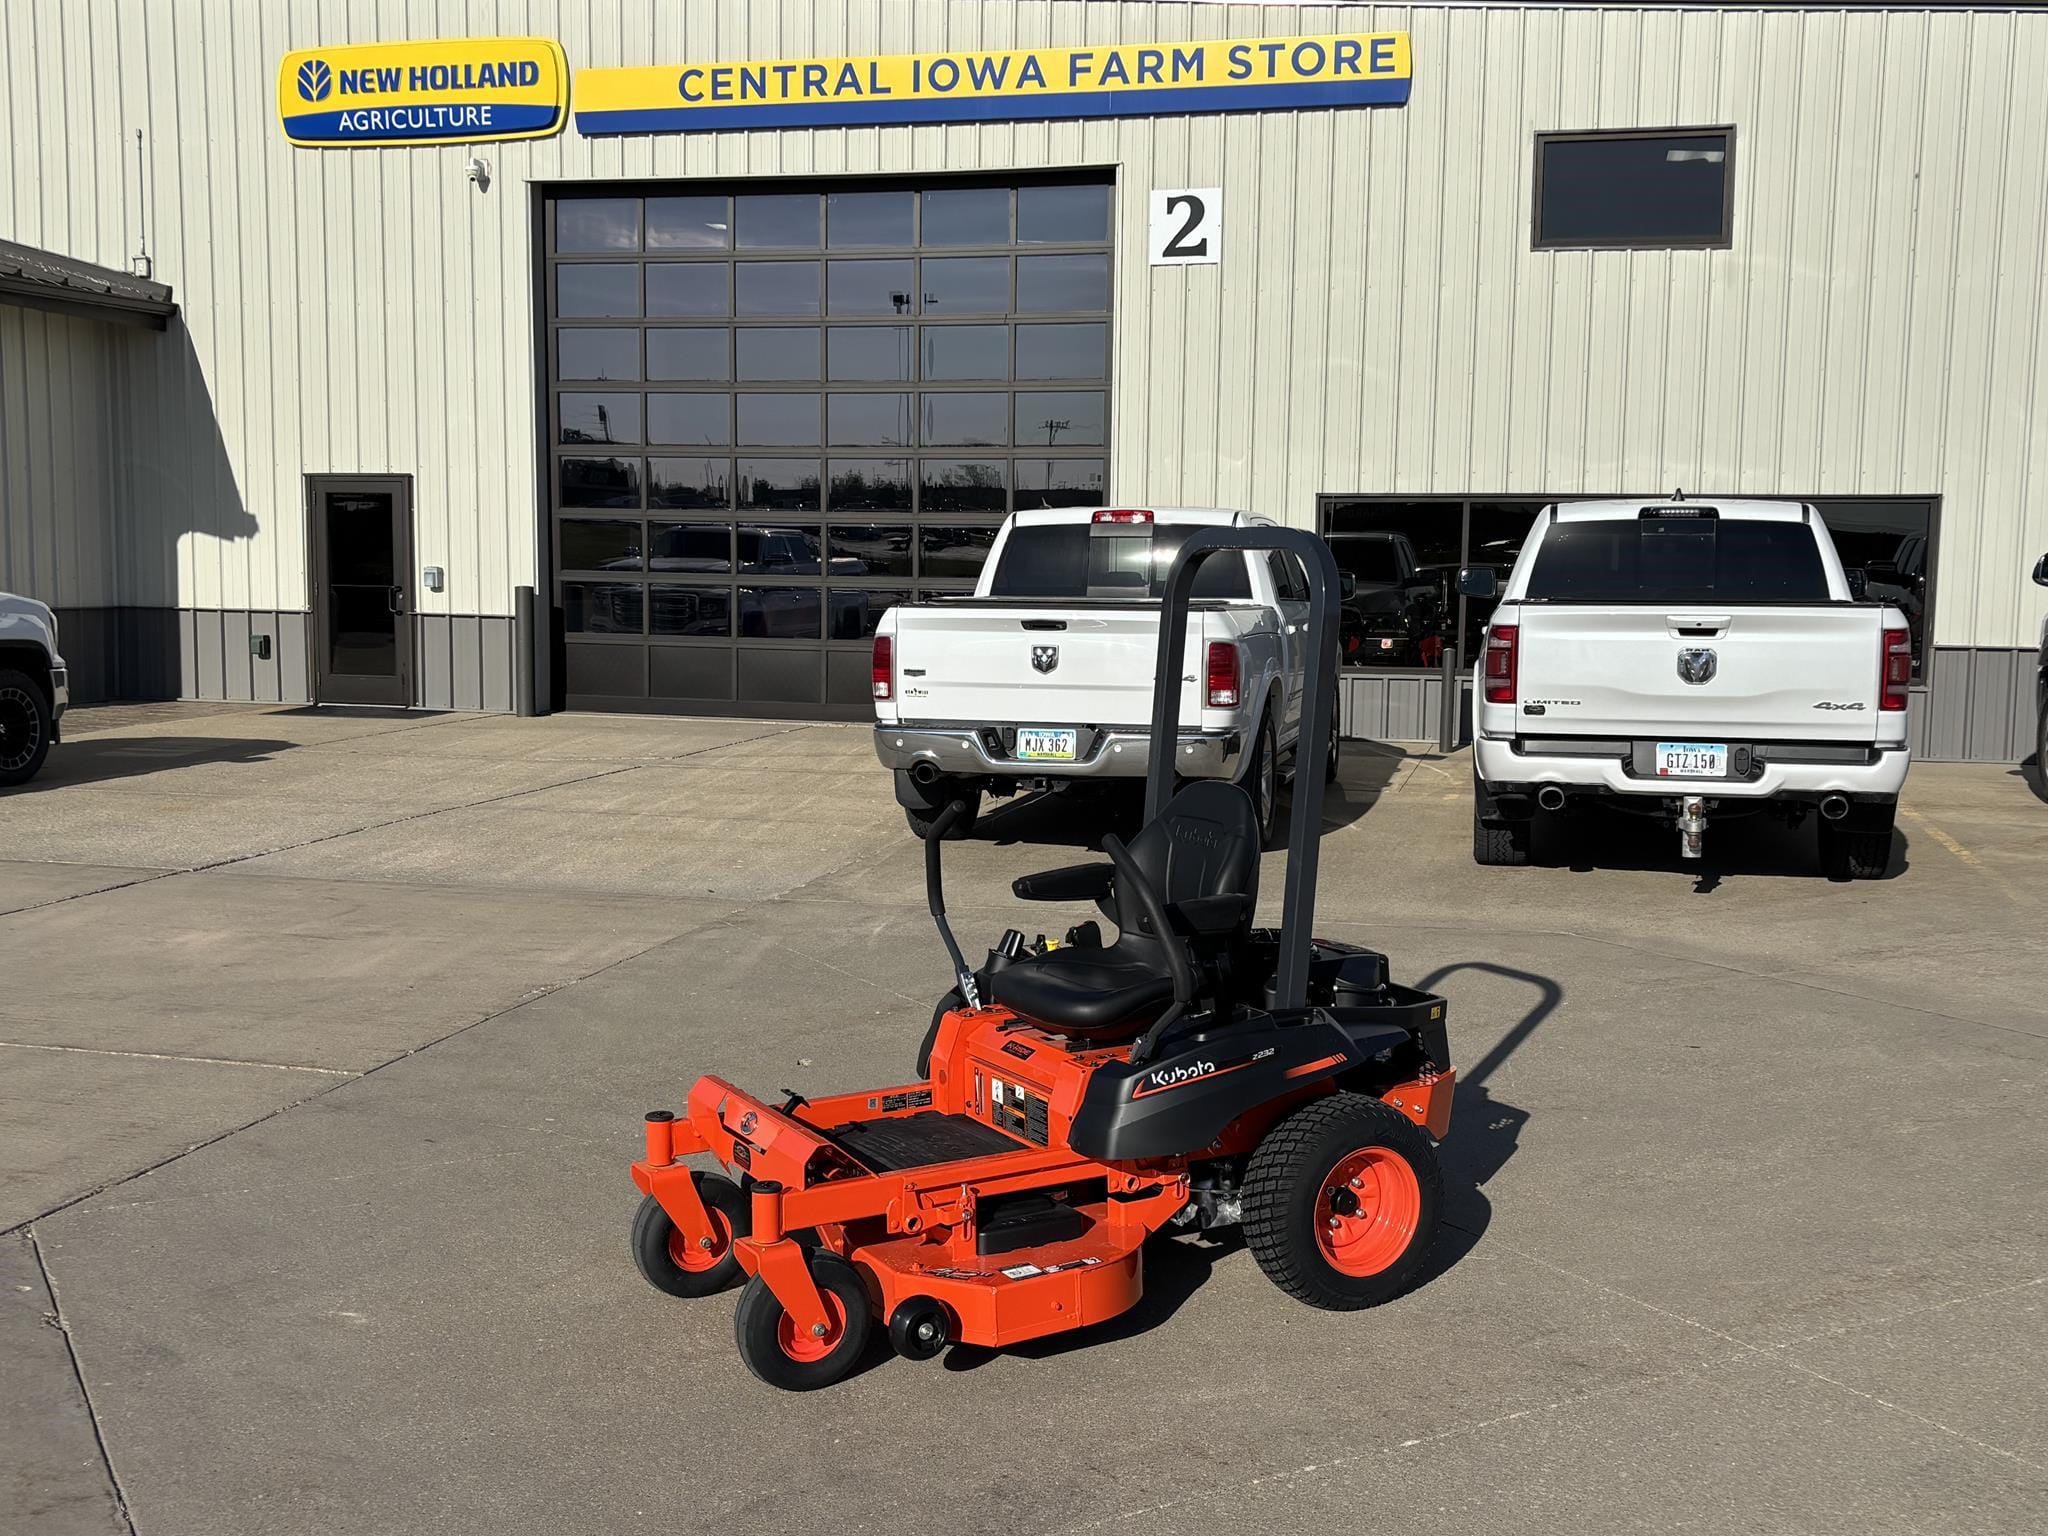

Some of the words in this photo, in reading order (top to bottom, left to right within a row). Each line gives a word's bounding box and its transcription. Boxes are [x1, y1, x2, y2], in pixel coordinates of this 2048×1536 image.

[339, 66, 401, 96] NEW
[408, 60, 540, 92] HOLLAND
[678, 60, 892, 103] CENTRAL
[912, 54, 1047, 95] IOWA
[1068, 47, 1205, 88] FARM
[1227, 37, 1397, 80] STORE
[338, 105, 493, 132] AGRICULTURE
[1161, 194, 1208, 258] 2
[1811, 700, 1867, 711] 4x4
[1025, 737, 1045, 752] MJX
[1048, 738, 1068, 753] 362
[1666, 752, 1689, 769] GTZ
[1692, 753, 1716, 770] 150
[1150, 1060, 1217, 1086] Kubota
